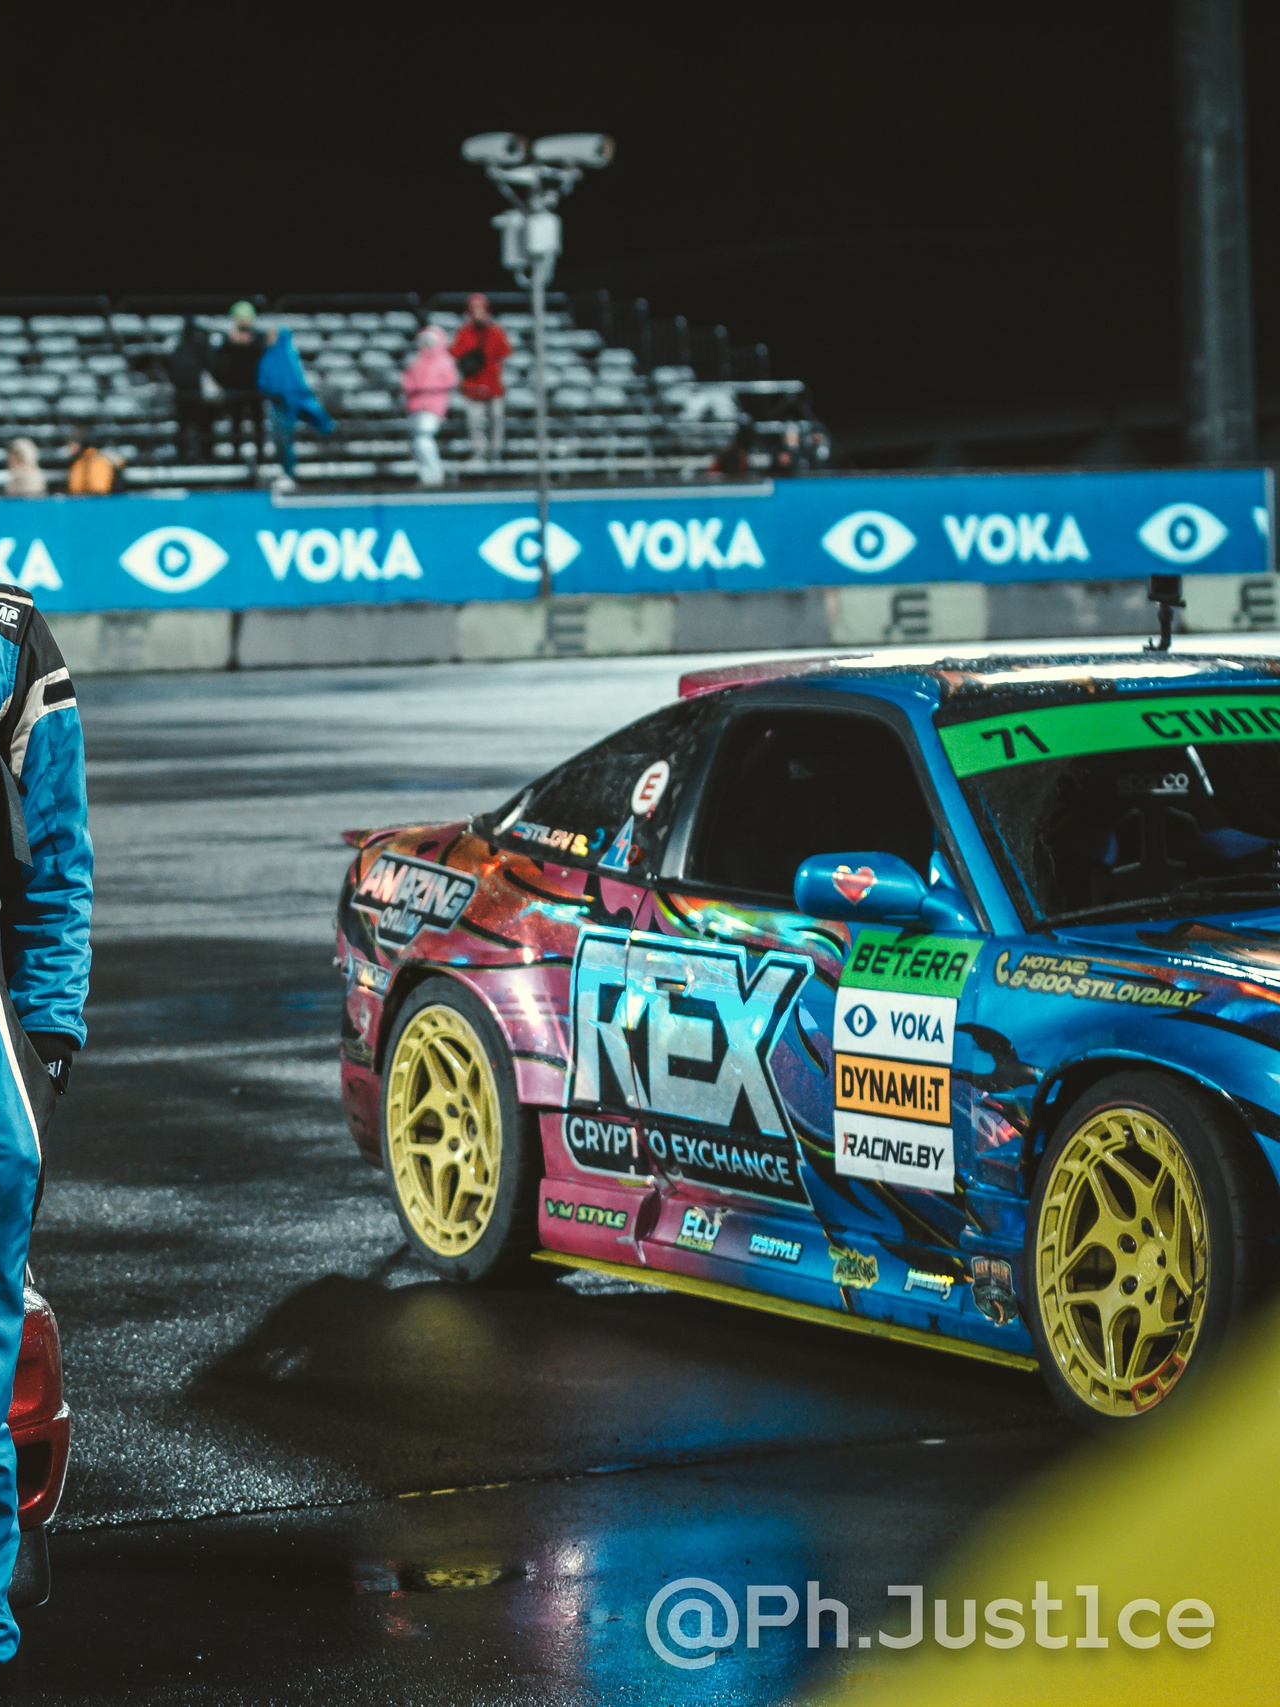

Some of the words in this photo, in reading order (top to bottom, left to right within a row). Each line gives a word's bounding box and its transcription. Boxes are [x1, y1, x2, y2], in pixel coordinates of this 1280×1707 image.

[254, 527, 423, 583] VOKA
[608, 517, 766, 572] VOKA
[943, 512, 1091, 566] VOKA
[980, 723, 1051, 760] 71
[359, 857, 472, 920] AMAZING
[852, 943, 969, 982] BET.ERA
[1009, 969, 1202, 1007] 8-800-STILOVDAILY
[573, 938, 798, 1138] REX
[891, 1010, 944, 1044] VOKA
[570, 1116, 667, 1160] CRYPTO
[671, 1134, 794, 1186] EXCHANGE
[577, 1205, 628, 1229] STYLE
